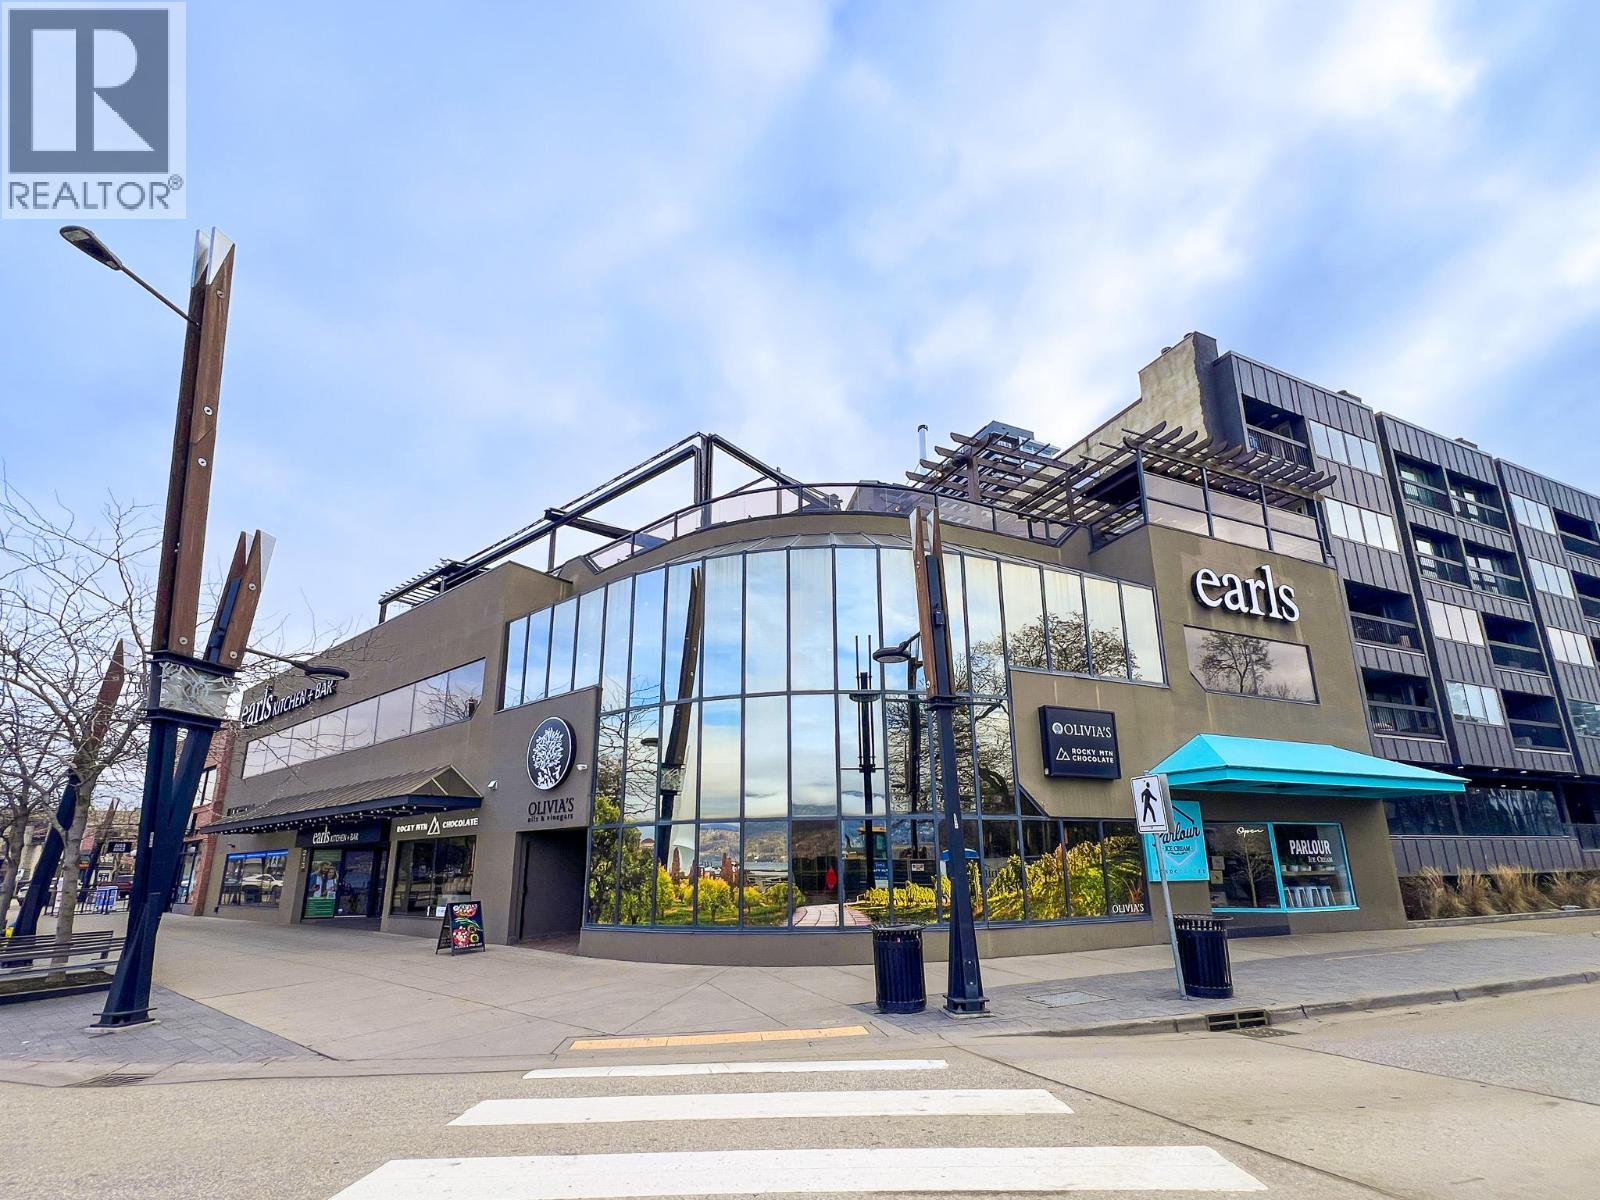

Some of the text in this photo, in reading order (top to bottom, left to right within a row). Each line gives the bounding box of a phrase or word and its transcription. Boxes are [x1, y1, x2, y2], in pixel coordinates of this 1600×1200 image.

[1191, 564, 1300, 622] earls
[240, 684, 273, 729] earls
[272, 691, 308, 717] KITCHEN
[315, 679, 335, 700] BAR
[1064, 723, 1112, 738] OLIVIA'S
[1071, 747, 1096, 755] ROCKY
[1072, 755, 1115, 764] CHOCOLATE
[528, 797, 575, 816] OLIVIA'S
[442, 817, 479, 829] CHOCOLATE
[1152, 822, 1201, 848] arlour
[1236, 826, 1264, 838] Open
[1289, 839, 1332, 855] PARLOUR
[1112, 902, 1145, 913] OLIVIA'S
